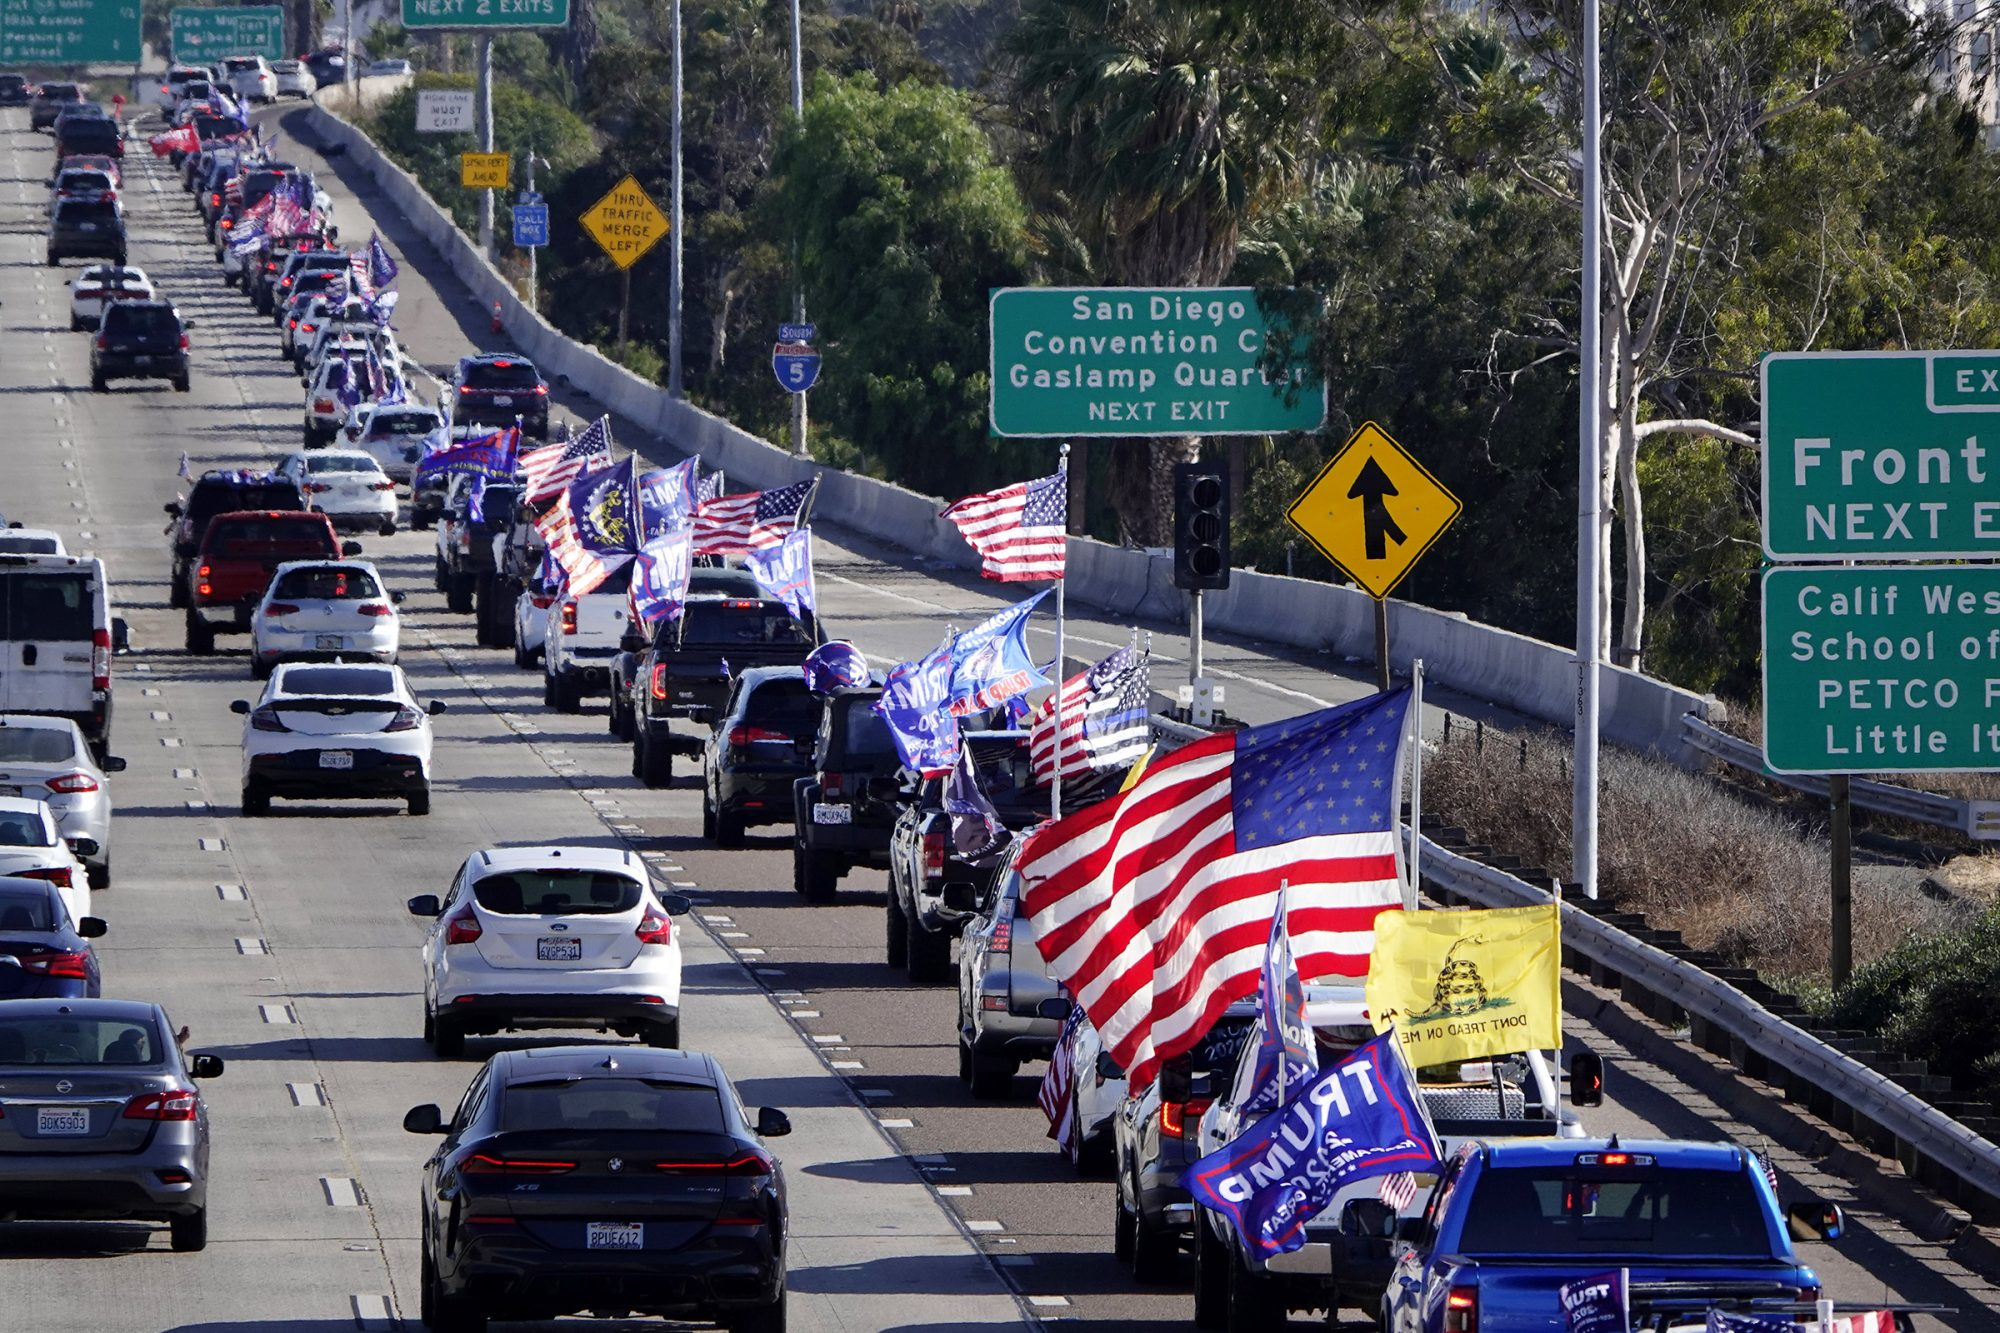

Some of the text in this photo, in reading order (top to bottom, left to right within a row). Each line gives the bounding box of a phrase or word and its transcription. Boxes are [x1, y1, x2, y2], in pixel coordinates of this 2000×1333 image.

[415, 0, 554, 15] NEXT 2 EXITS
[432, 105, 461, 114] MUST
[433, 117, 459, 127] EXIT
[613, 192, 644, 207] THRU
[517, 215, 544, 224] CALL
[602, 207, 653, 221] TRAFFIC
[519, 225, 540, 234] BOX
[602, 224, 650, 237] MERGE
[609, 241, 641, 252] LEFT
[1072, 296, 1245, 327] San Diego
[781, 326, 813, 338] SOUTH
[1024, 330, 1218, 355] Convention
[789, 362, 804, 383] 5
[1009, 364, 1157, 392] Gaslamp
[1089, 401, 1230, 421] NEXT EXIT
[1794, 435, 1987, 486] Front
[1806, 502, 1948, 541] NEXT
[1798, 585, 1898, 616] Calif
[1791, 629, 2000, 661] School of
[1819, 678, 1959, 709] PETCO
[1826, 724, 1947, 754] Little
